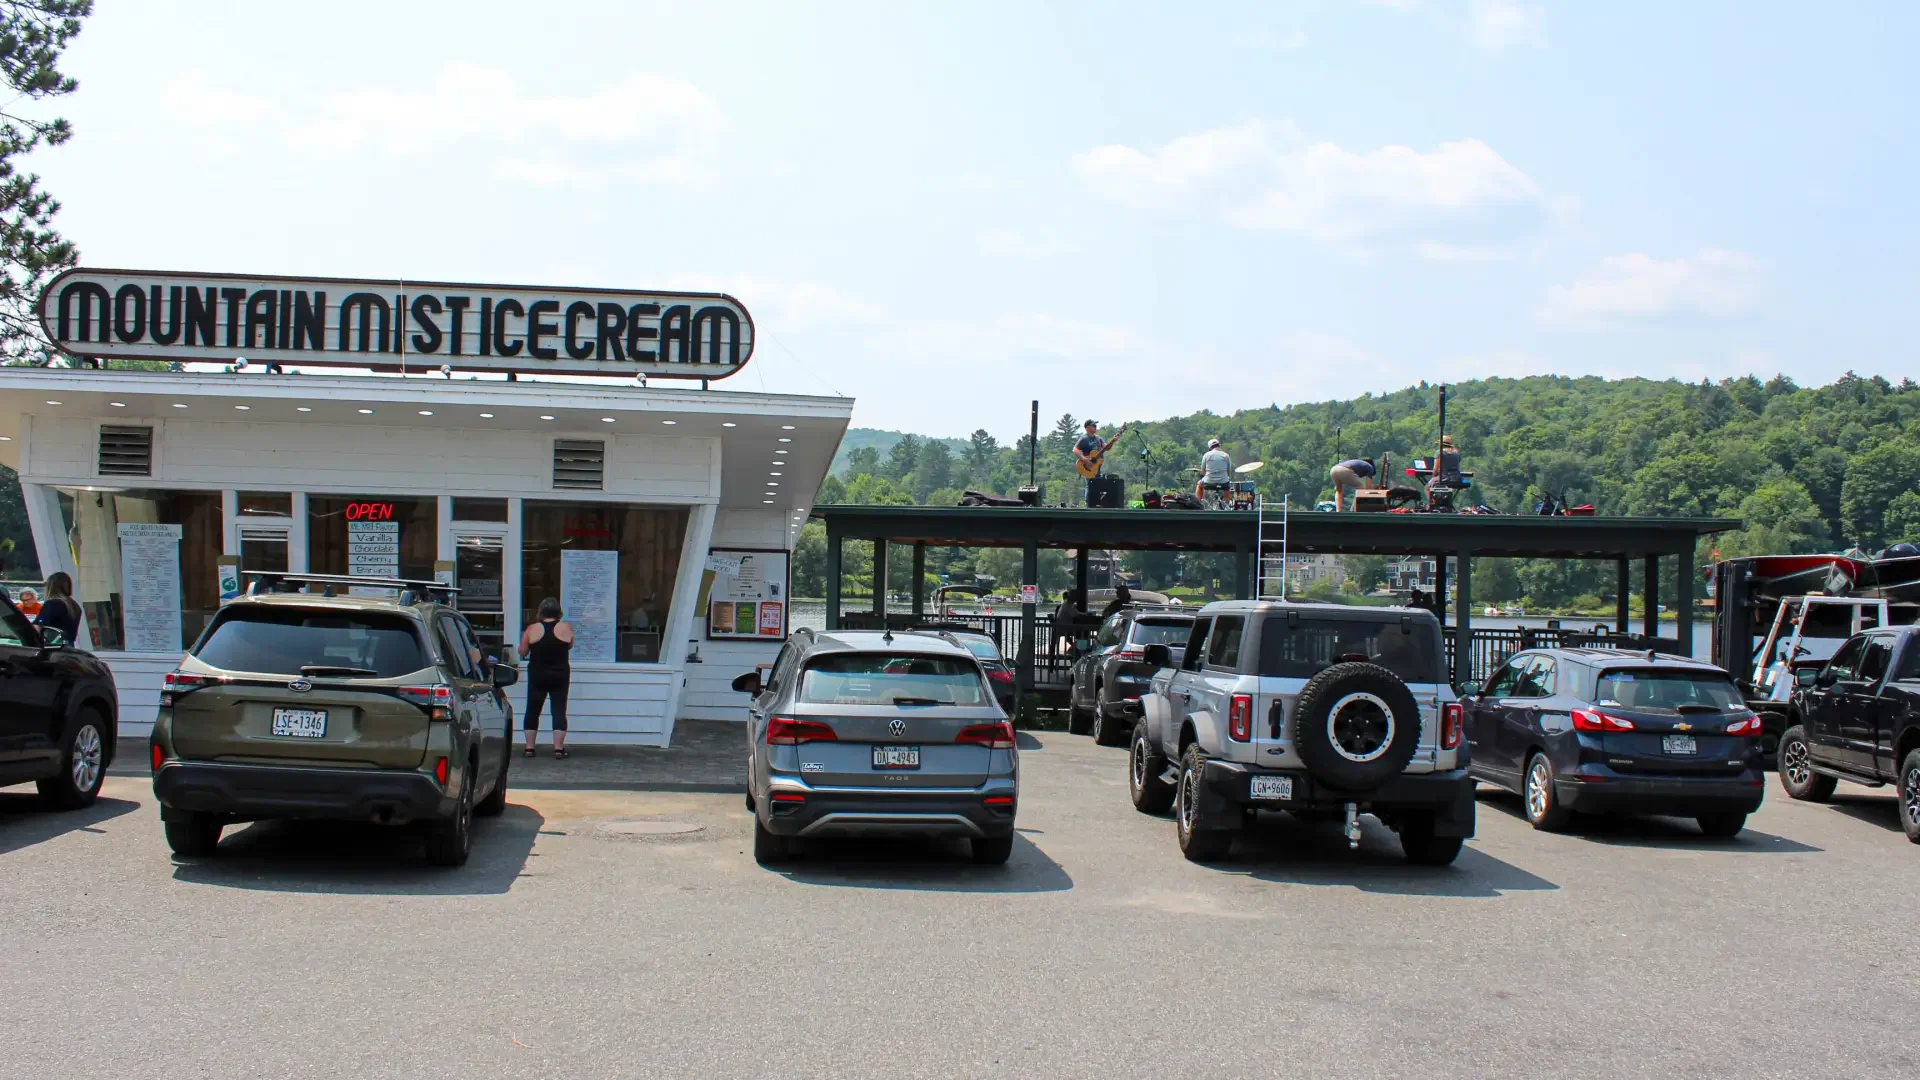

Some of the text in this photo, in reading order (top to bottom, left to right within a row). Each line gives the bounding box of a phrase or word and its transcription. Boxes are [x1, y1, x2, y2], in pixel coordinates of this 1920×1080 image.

[58, 281, 741, 365] MOUNTAIN MIST ICE CREAM
[345, 502, 393, 520] OPEN
[356, 533, 393, 542] Vanilla
[354, 544, 394, 553] Chocolate
[356, 555, 392, 564] Cherry
[356, 566, 392, 574] Banana
